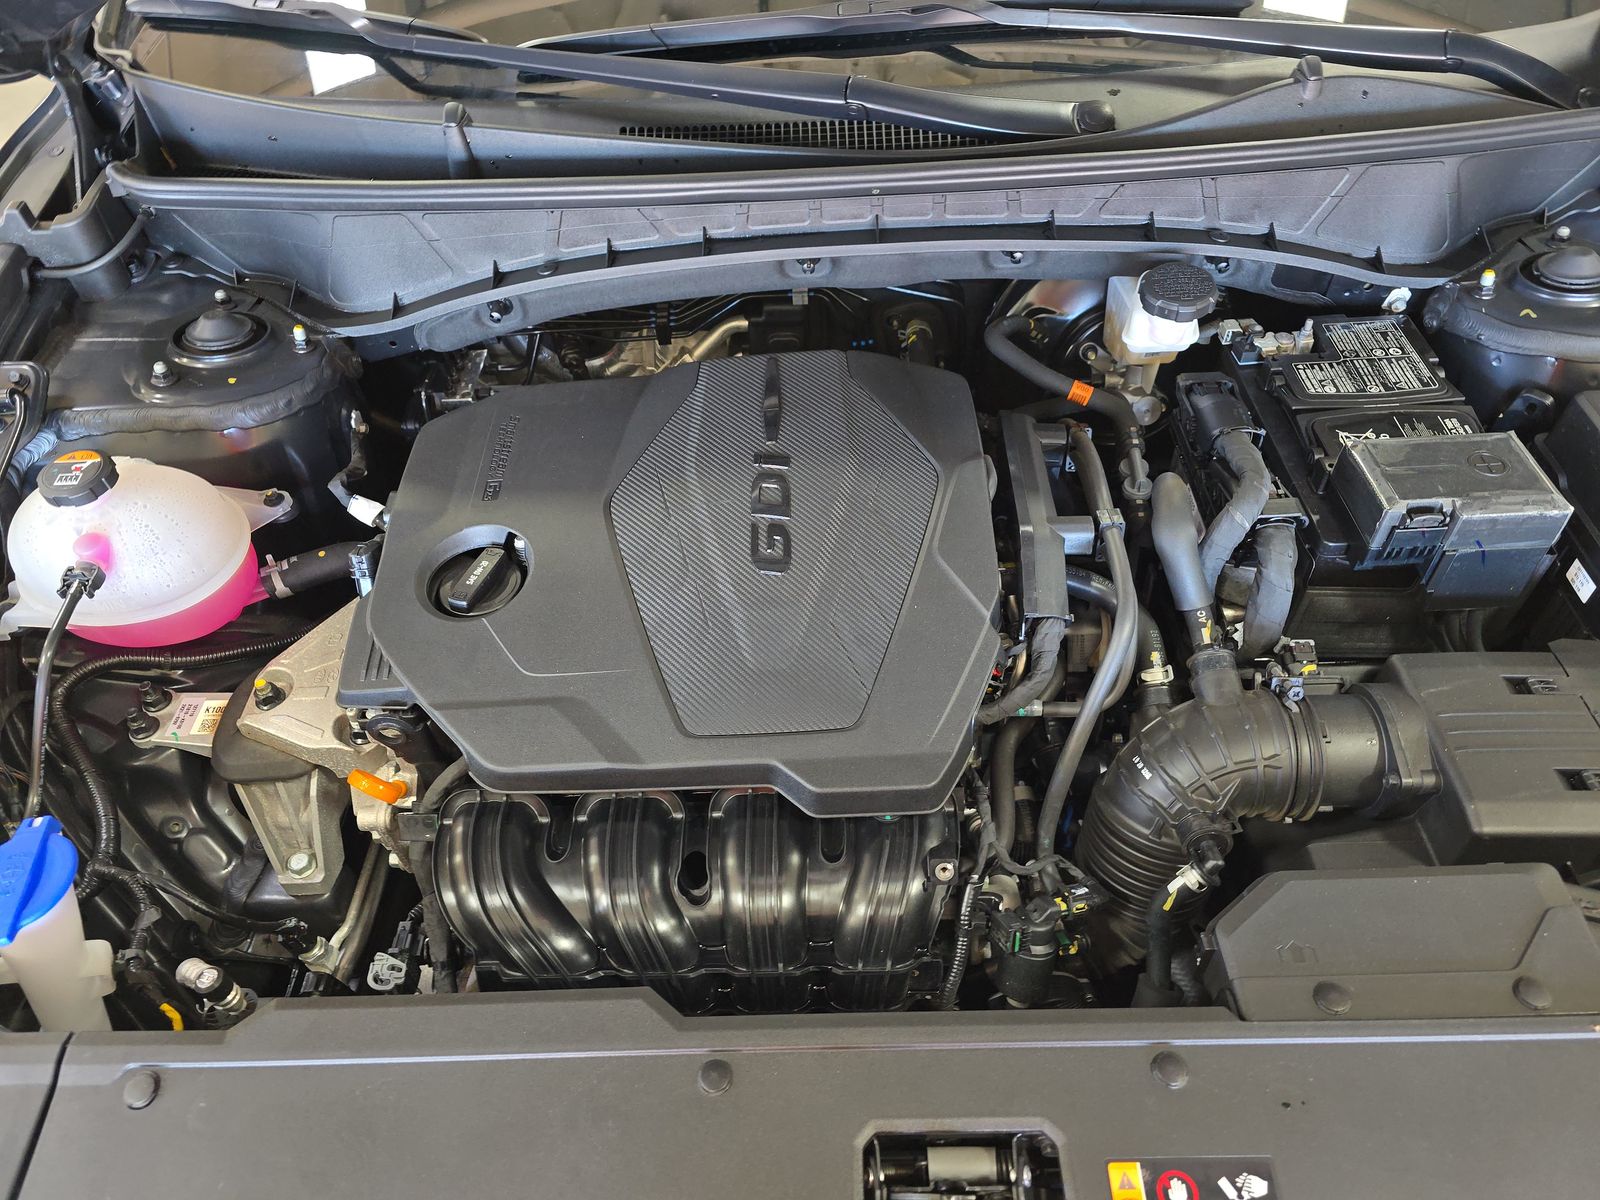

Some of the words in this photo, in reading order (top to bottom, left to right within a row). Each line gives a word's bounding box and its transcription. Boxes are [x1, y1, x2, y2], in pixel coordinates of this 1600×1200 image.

[487, 422, 508, 479] TECHNOLOGY
[495, 414, 520, 478] Smartstream
[751, 452, 792, 577] GDi
[466, 574, 479, 585] SAE
